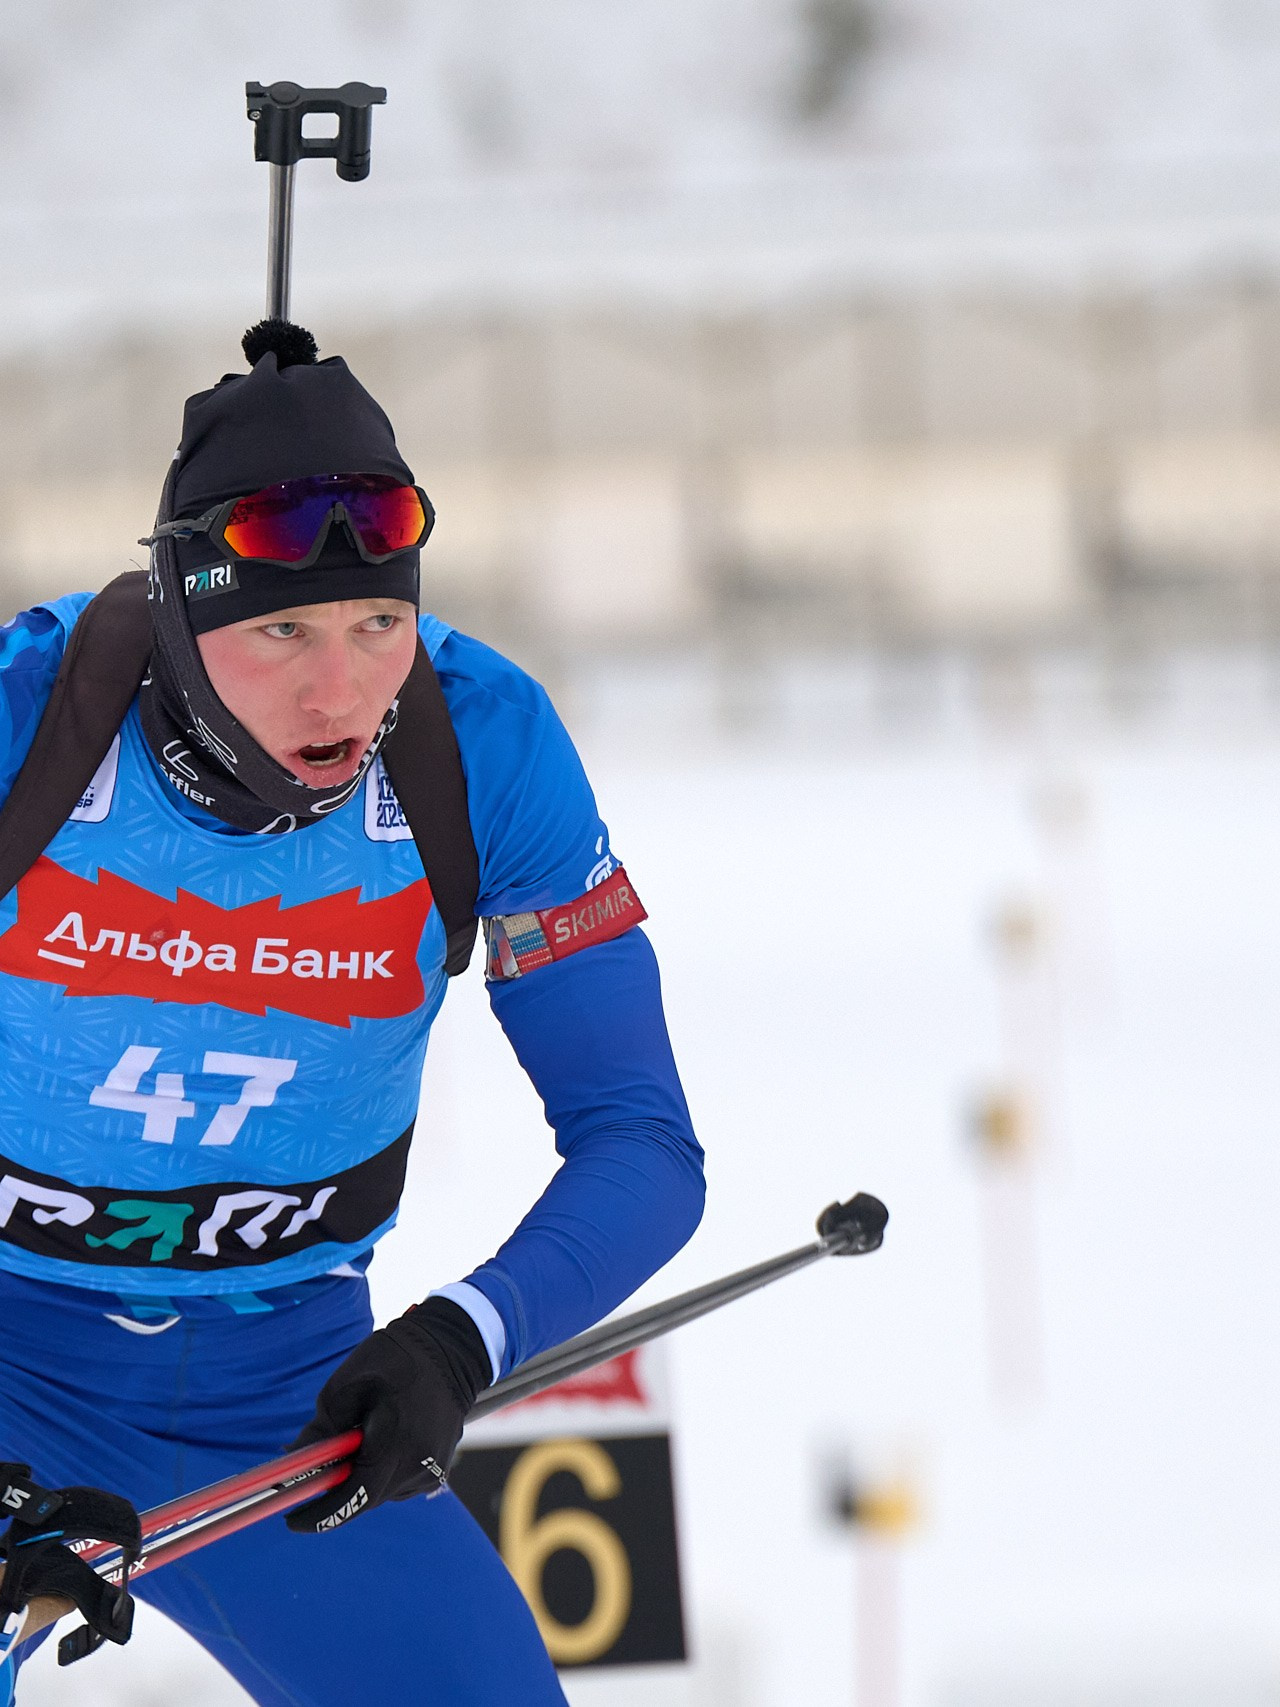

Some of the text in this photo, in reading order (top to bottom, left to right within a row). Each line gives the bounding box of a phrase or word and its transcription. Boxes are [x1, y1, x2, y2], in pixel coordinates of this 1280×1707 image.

[184, 564, 231, 596] PARI
[38, 911, 395, 979] Альфа Банк
[554, 886, 634, 943] SKIMIR
[89, 1045, 298, 1145] 47
[500, 1437, 632, 1664] 6
